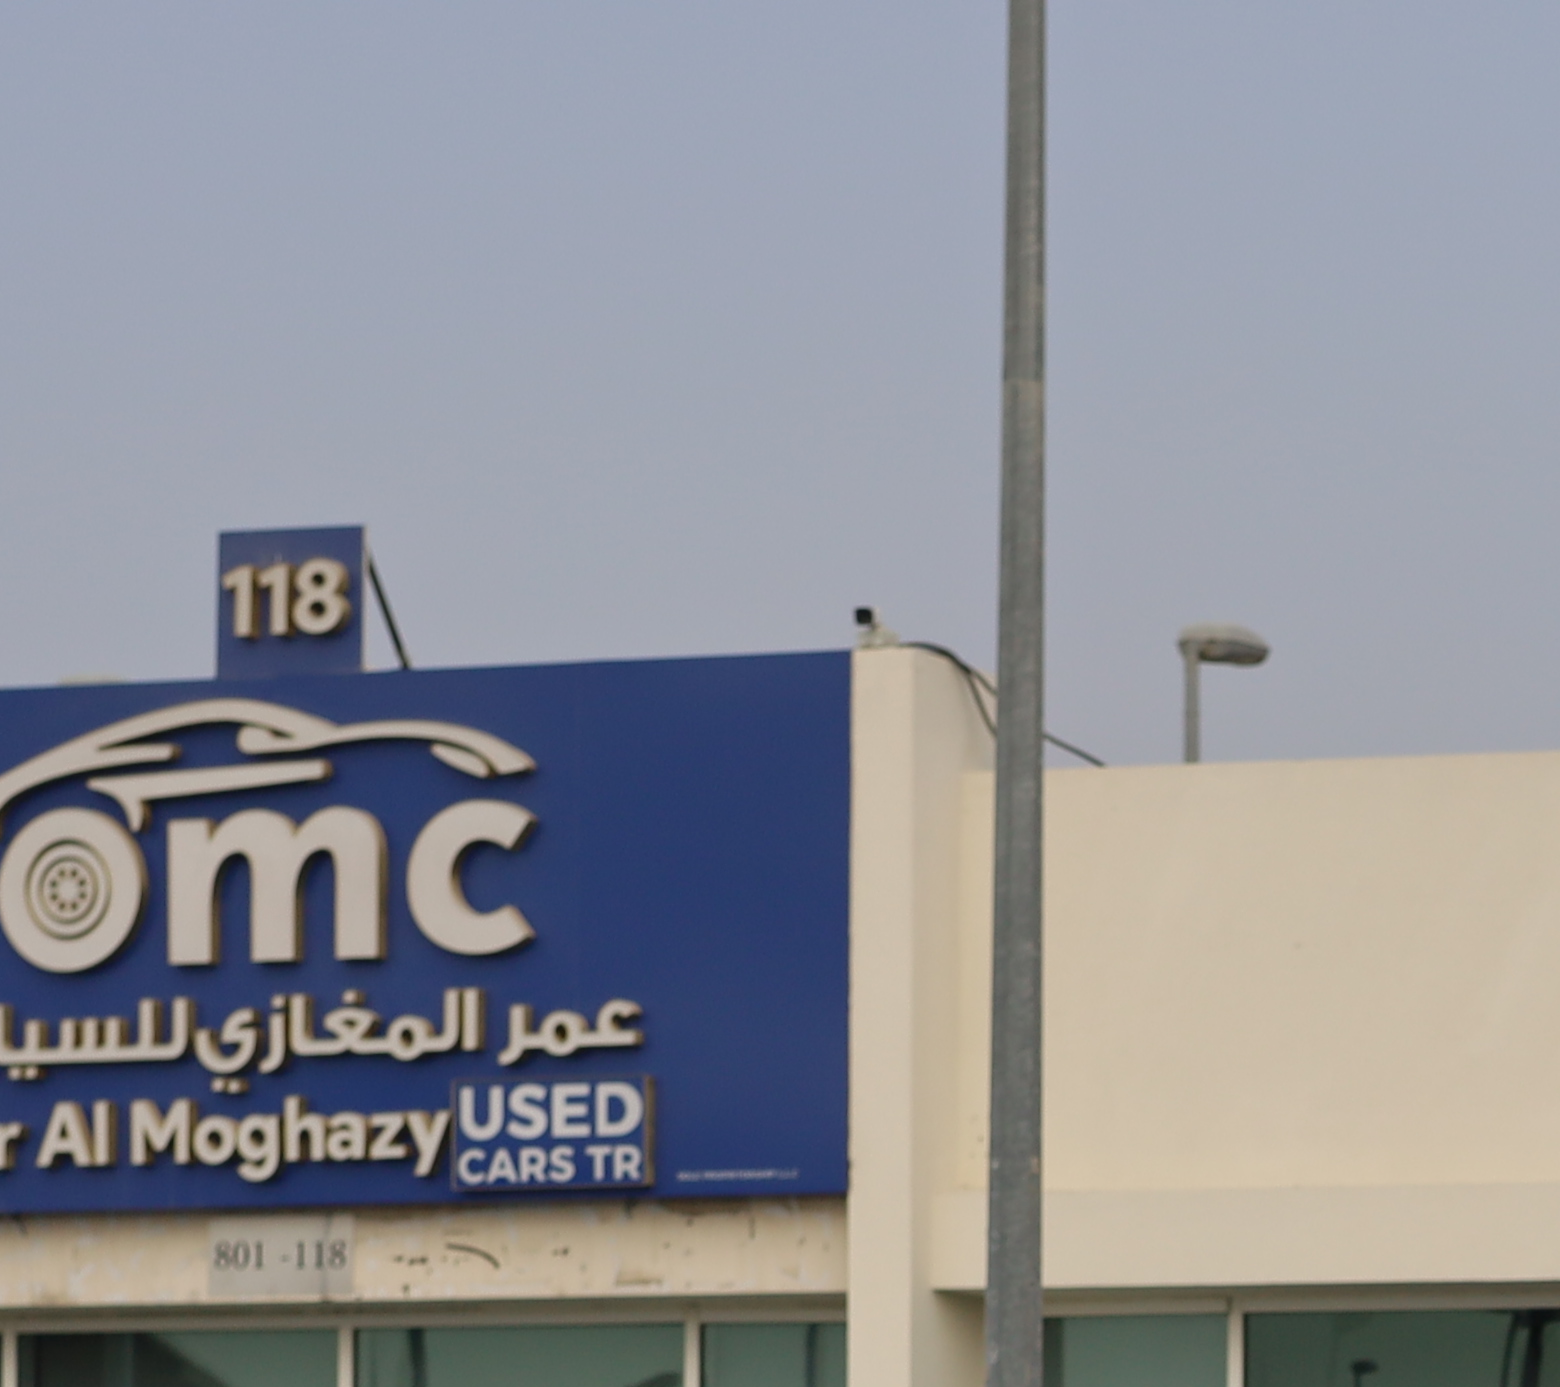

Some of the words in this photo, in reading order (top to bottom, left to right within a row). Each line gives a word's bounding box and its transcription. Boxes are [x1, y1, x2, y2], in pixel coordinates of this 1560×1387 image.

[221, 556, 351, 639] 118
[193, 986, 485, 1094] المغازي
[497, 998, 643, 1066] عمر
[36, 1099, 118, 1167] Al
[130, 1094, 453, 1183] Moghazy
[458, 1081, 644, 1142] USED
[457, 1147, 576, 1186] CARS
[586, 1144, 642, 1182] TR
[213, 1238, 265, 1272] 801
[280, 1238, 347, 1271] -118
